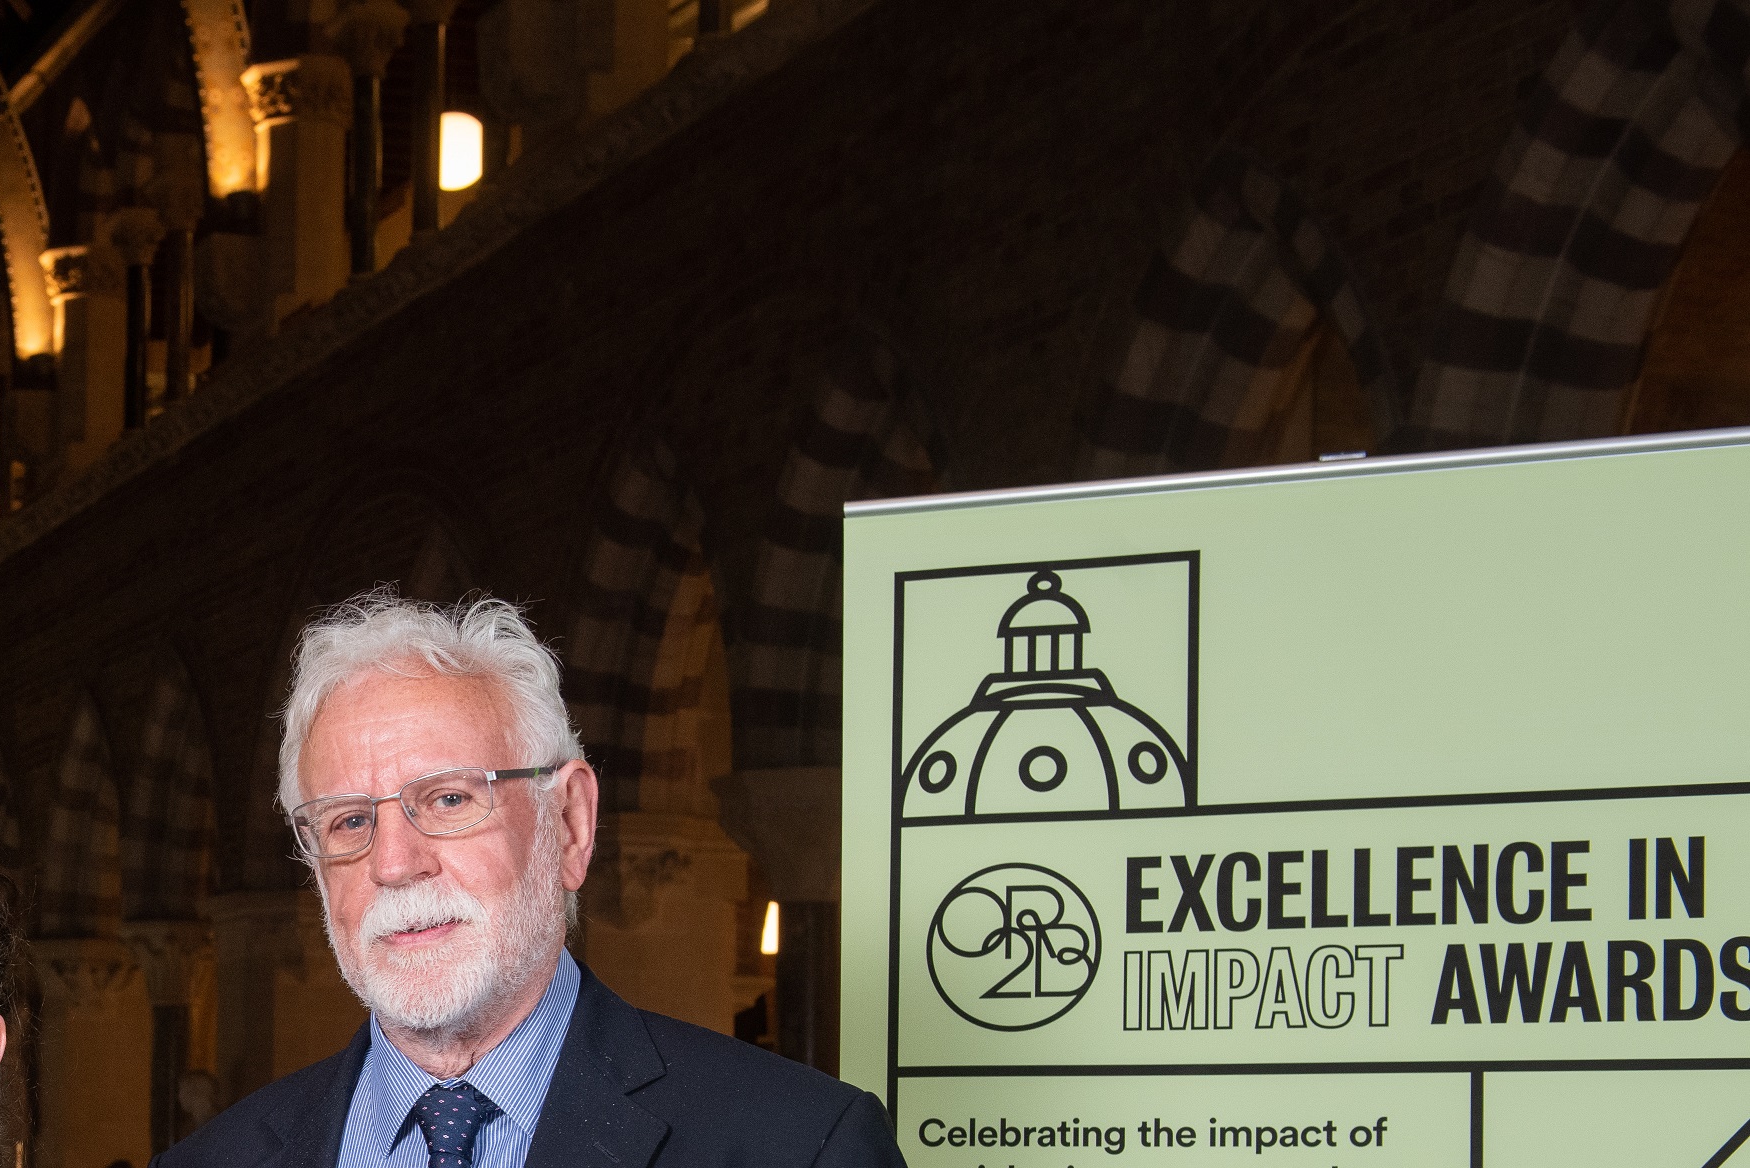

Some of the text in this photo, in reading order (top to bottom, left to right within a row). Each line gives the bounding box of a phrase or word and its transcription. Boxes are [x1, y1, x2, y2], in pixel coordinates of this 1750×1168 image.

[1124, 836, 1706, 934] EXCELLENCE IN
[1122, 936, 1750, 1031] IMPACT AWARDS
[918, 1117, 1388, 1154] Celebrating the impact of
